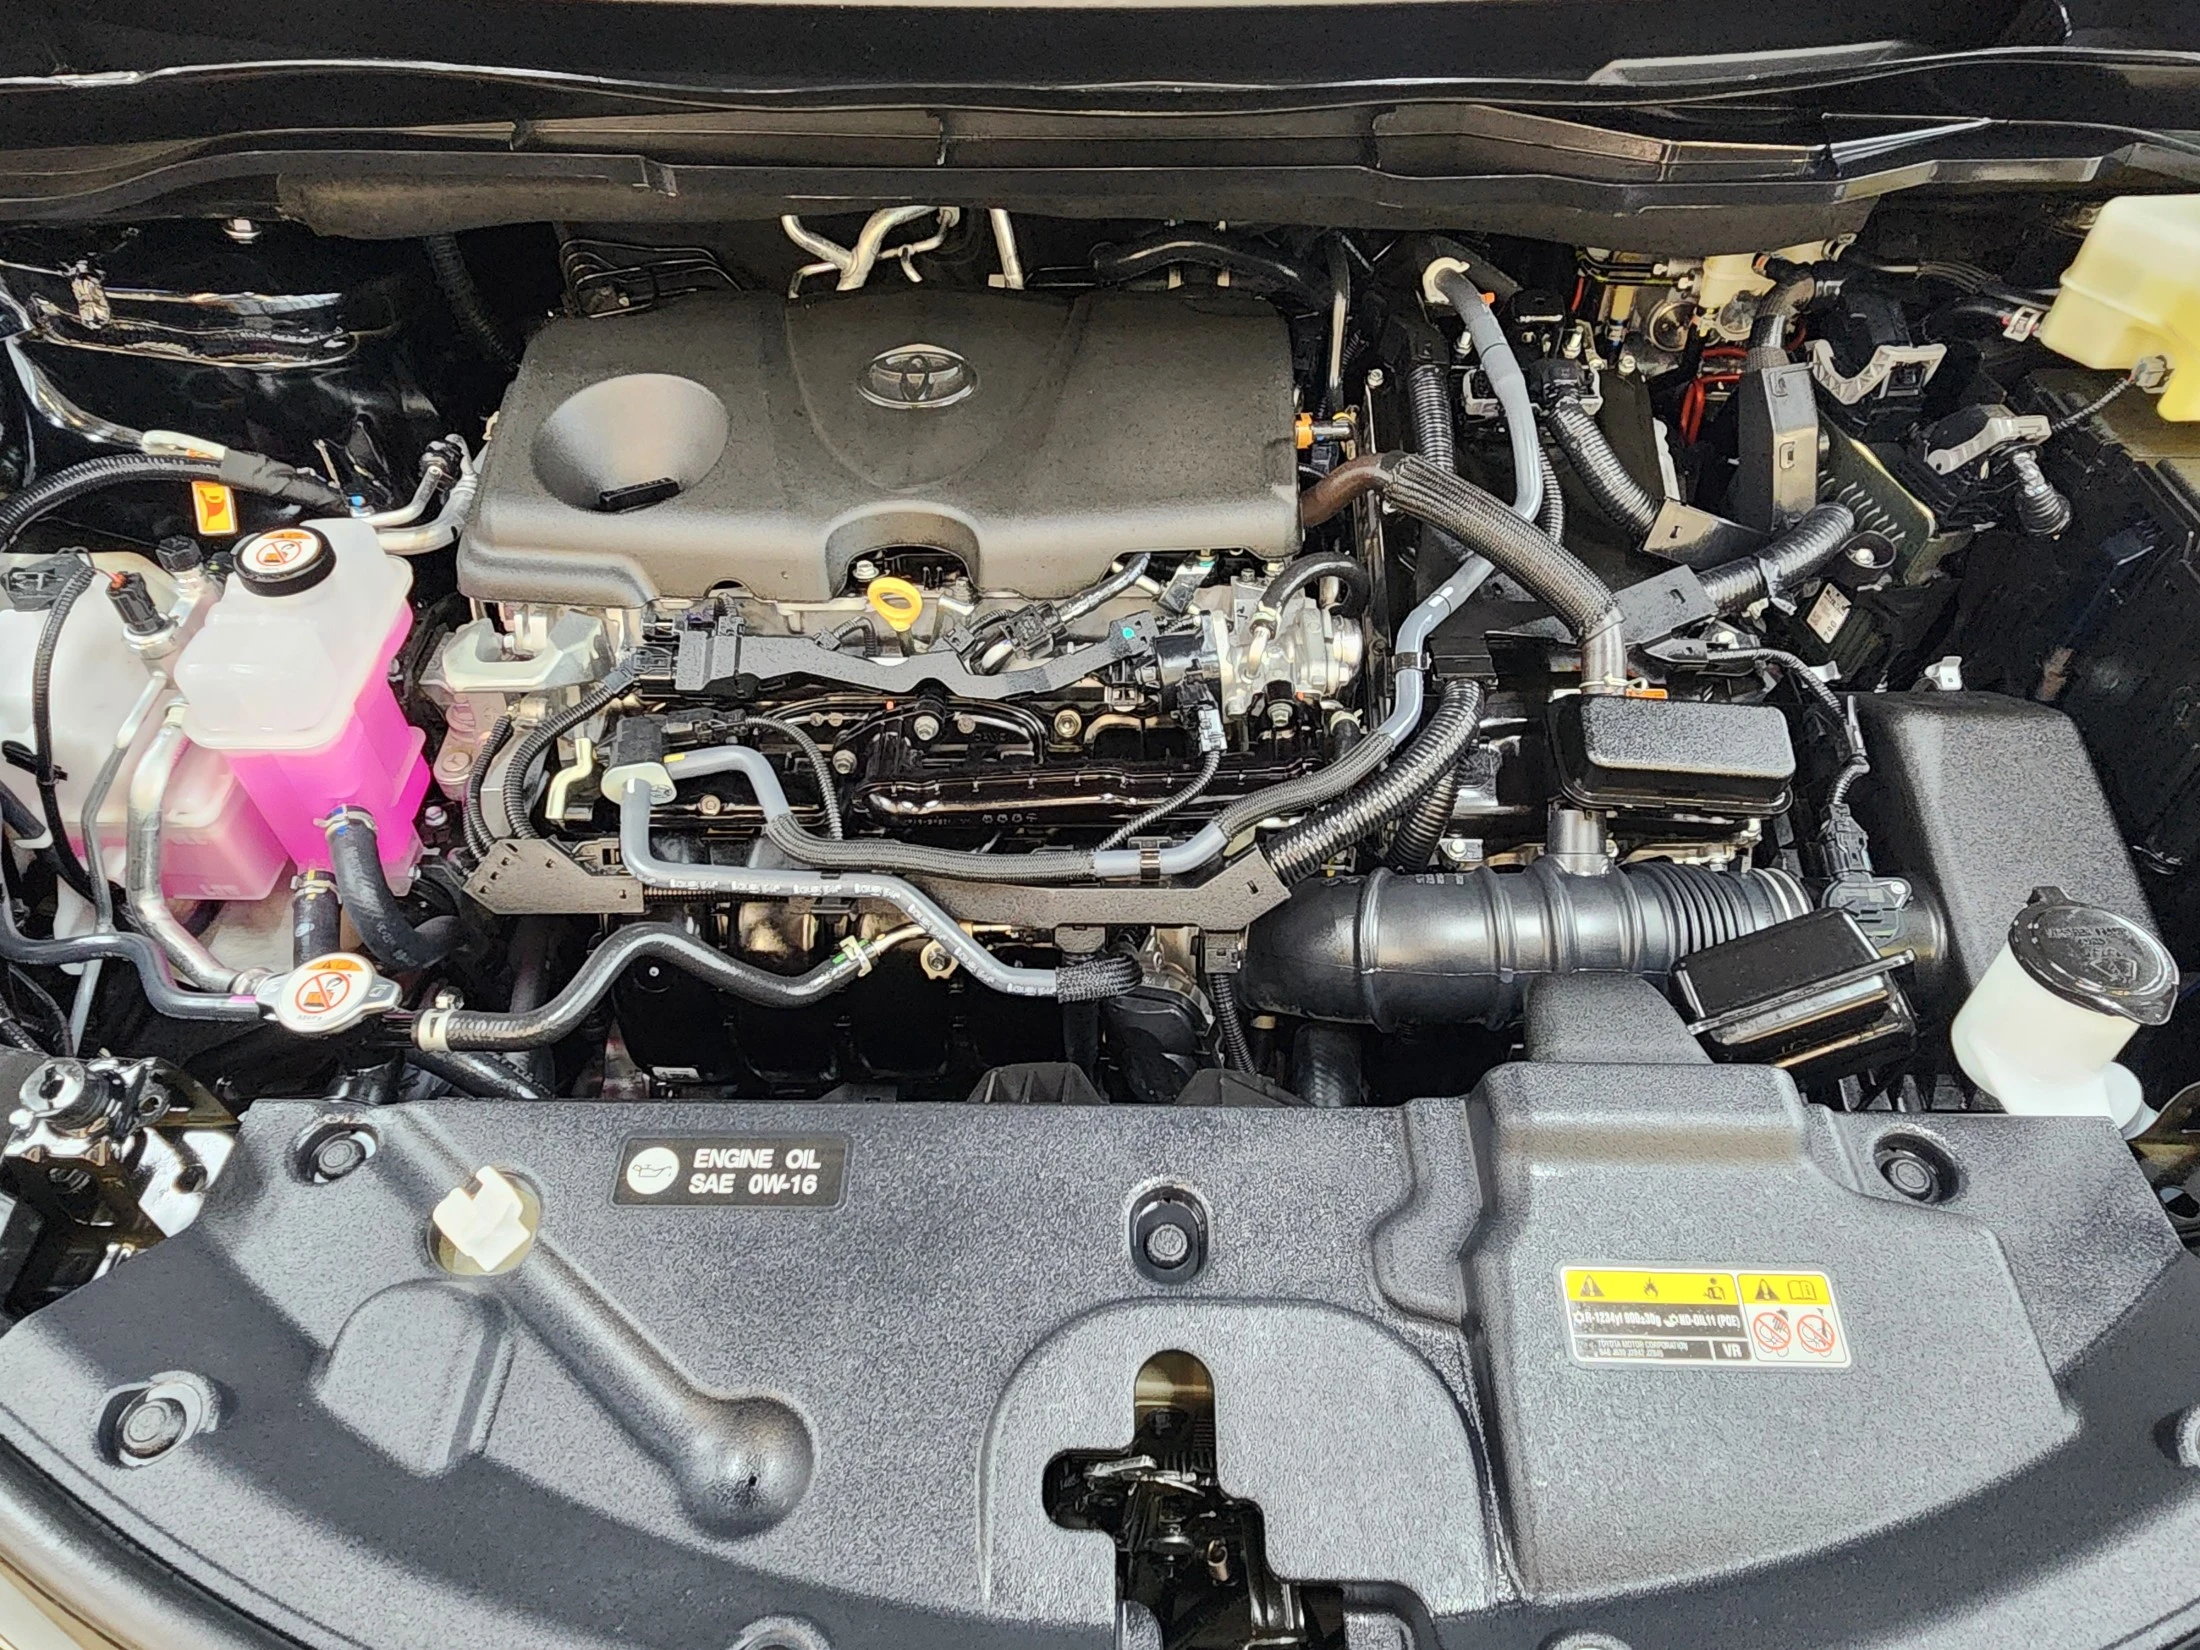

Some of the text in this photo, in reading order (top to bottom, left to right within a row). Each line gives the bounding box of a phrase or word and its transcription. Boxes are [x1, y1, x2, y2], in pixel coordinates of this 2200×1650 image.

[693, 1148, 822, 1170] ENGINE OIL
[688, 1173, 818, 1195] SAE 0W-16
[1717, 1314, 1741, 1329] (POE)
[1598, 1339, 1689, 1351] TOYOTA MOTOR CORPORATION
[1722, 1342, 1743, 1358] VR
